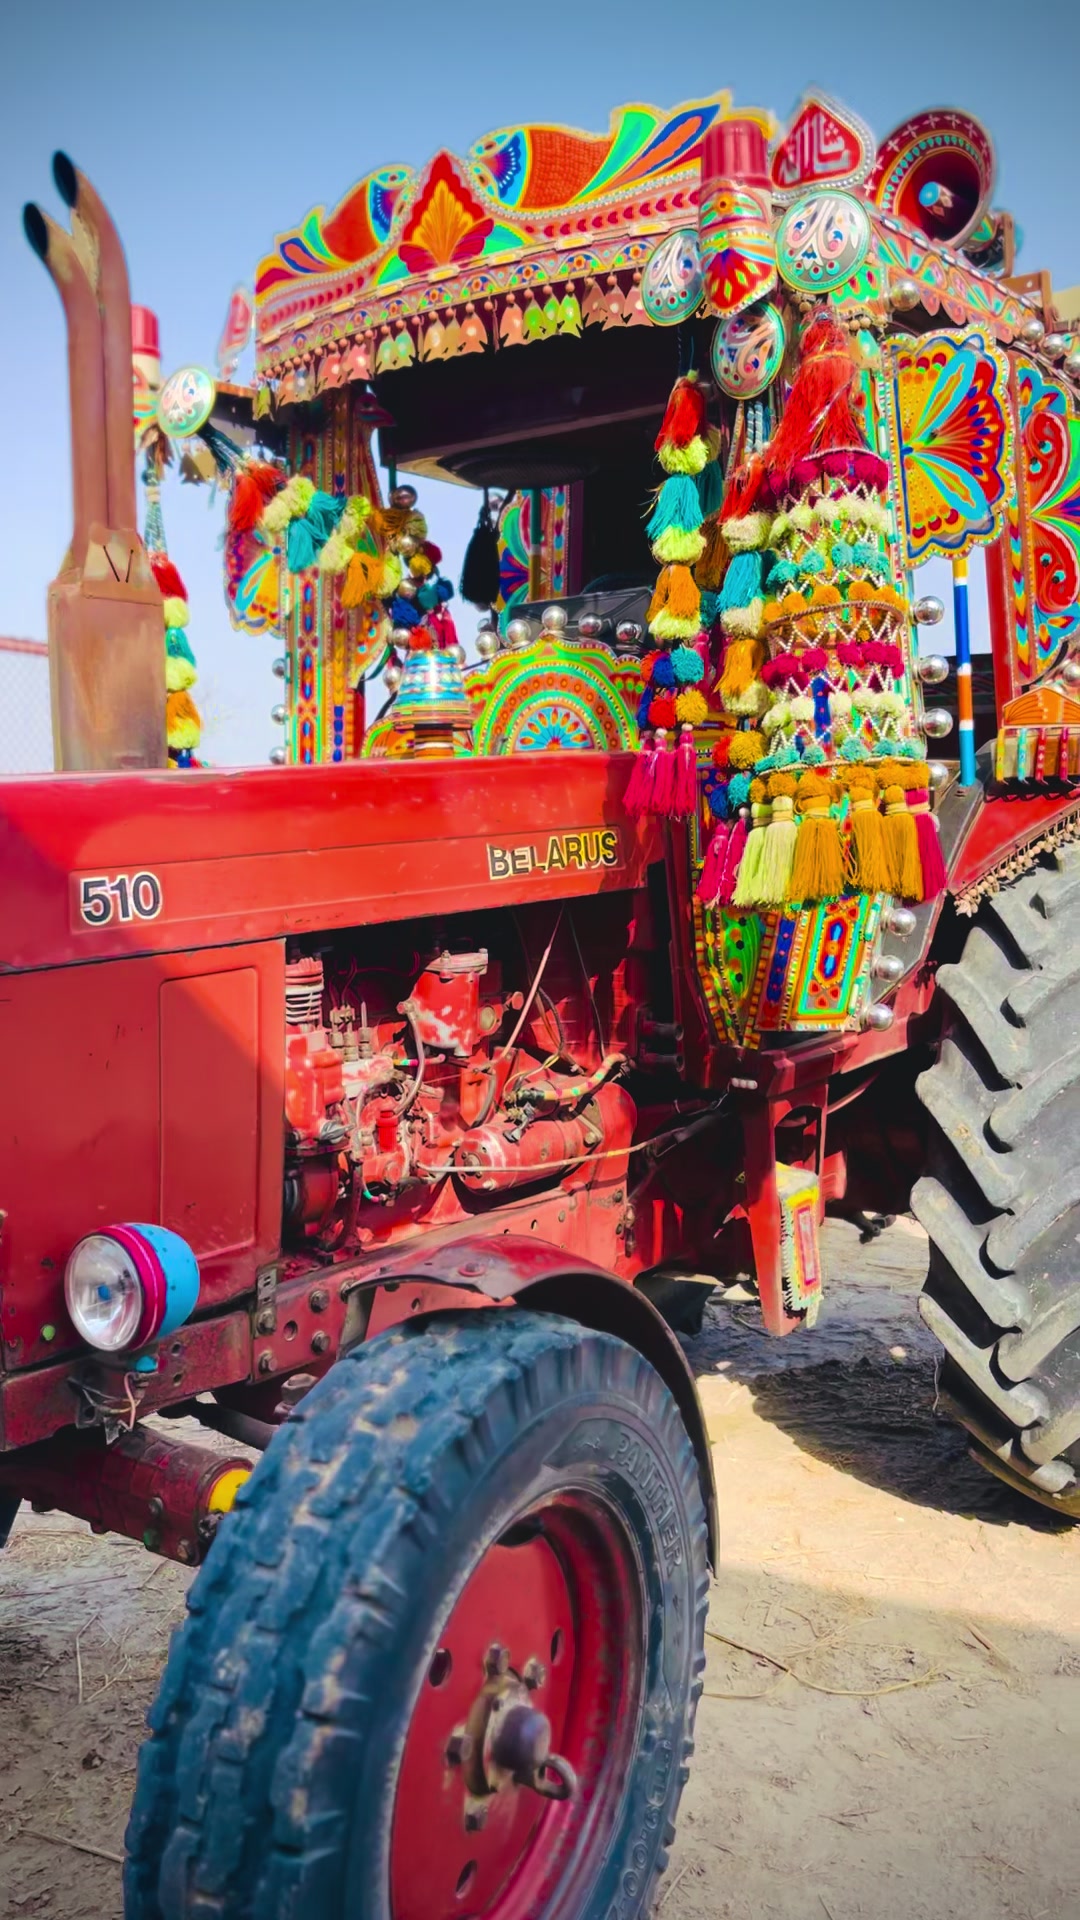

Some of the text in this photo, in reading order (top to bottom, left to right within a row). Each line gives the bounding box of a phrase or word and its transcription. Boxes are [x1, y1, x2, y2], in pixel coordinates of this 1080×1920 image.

[487, 831, 618, 880] BELARUS
[81, 872, 162, 925] 510
[609, 1432, 683, 1576] PANTHER
